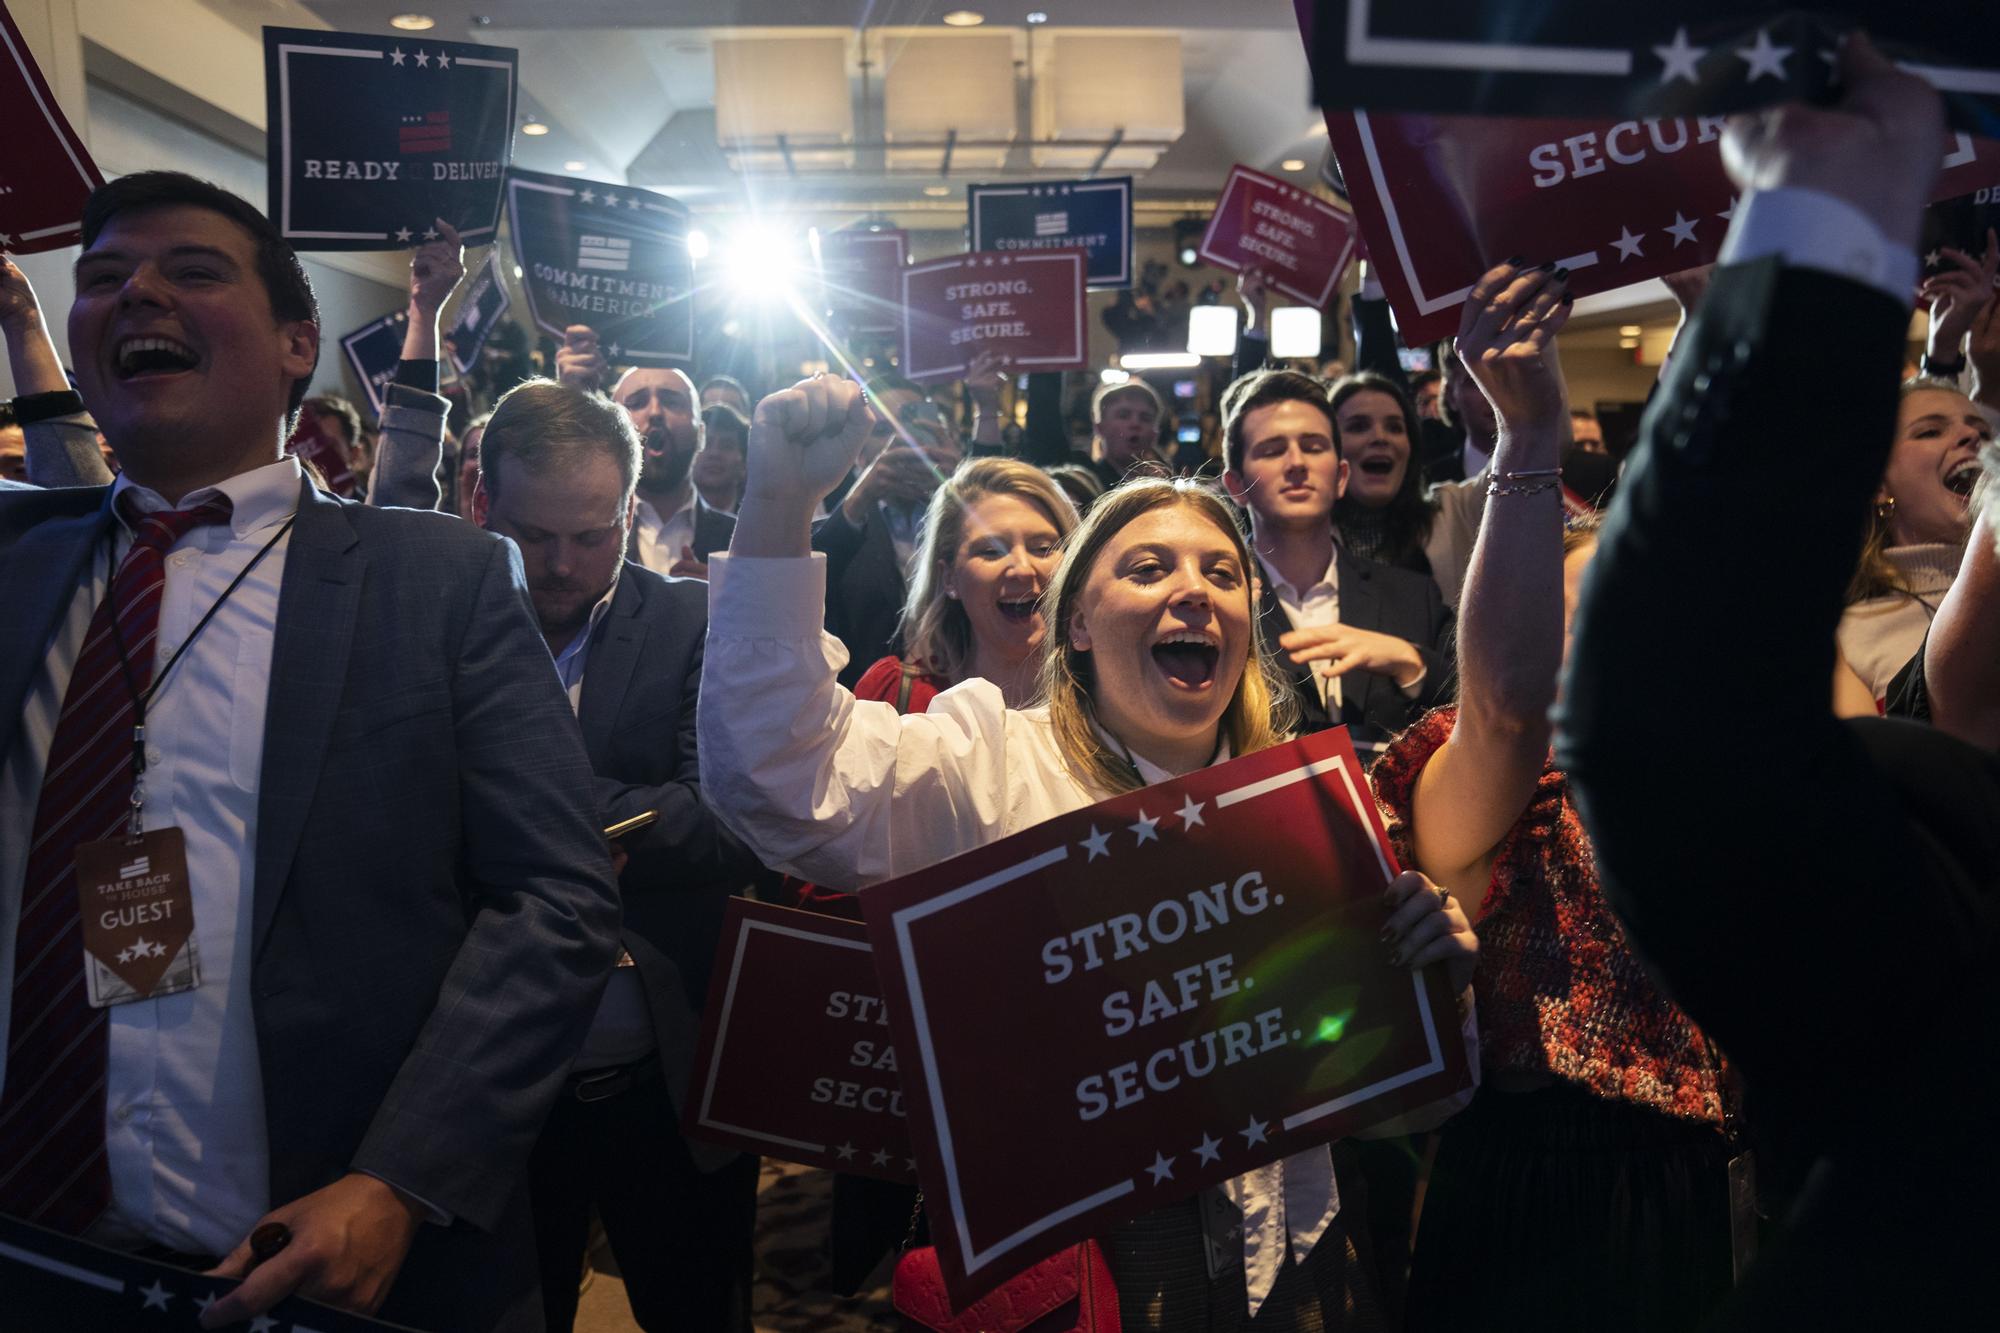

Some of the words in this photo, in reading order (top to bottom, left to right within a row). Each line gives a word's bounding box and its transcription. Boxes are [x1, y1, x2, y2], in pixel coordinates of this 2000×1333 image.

[304, 159, 400, 180] READY
[995, 234, 1107, 251] COMMITMENT
[534, 262, 676, 301] COMMITMENT
[945, 280, 1033, 301] STRONG.
[558, 289, 657, 318] AMERICA
[961, 302, 1016, 321] SAFE.
[950, 322, 1031, 346] SECURE.
[97, 880, 133, 894] TAKE
[136, 873, 171, 887] BACK
[120, 884, 167, 901] HOUSE
[100, 899, 174, 930] GUEST
[1041, 871, 1284, 985] STRONG.
[1102, 953, 1254, 1037] SAFE.
[1075, 1007, 1301, 1121] SECURE.
